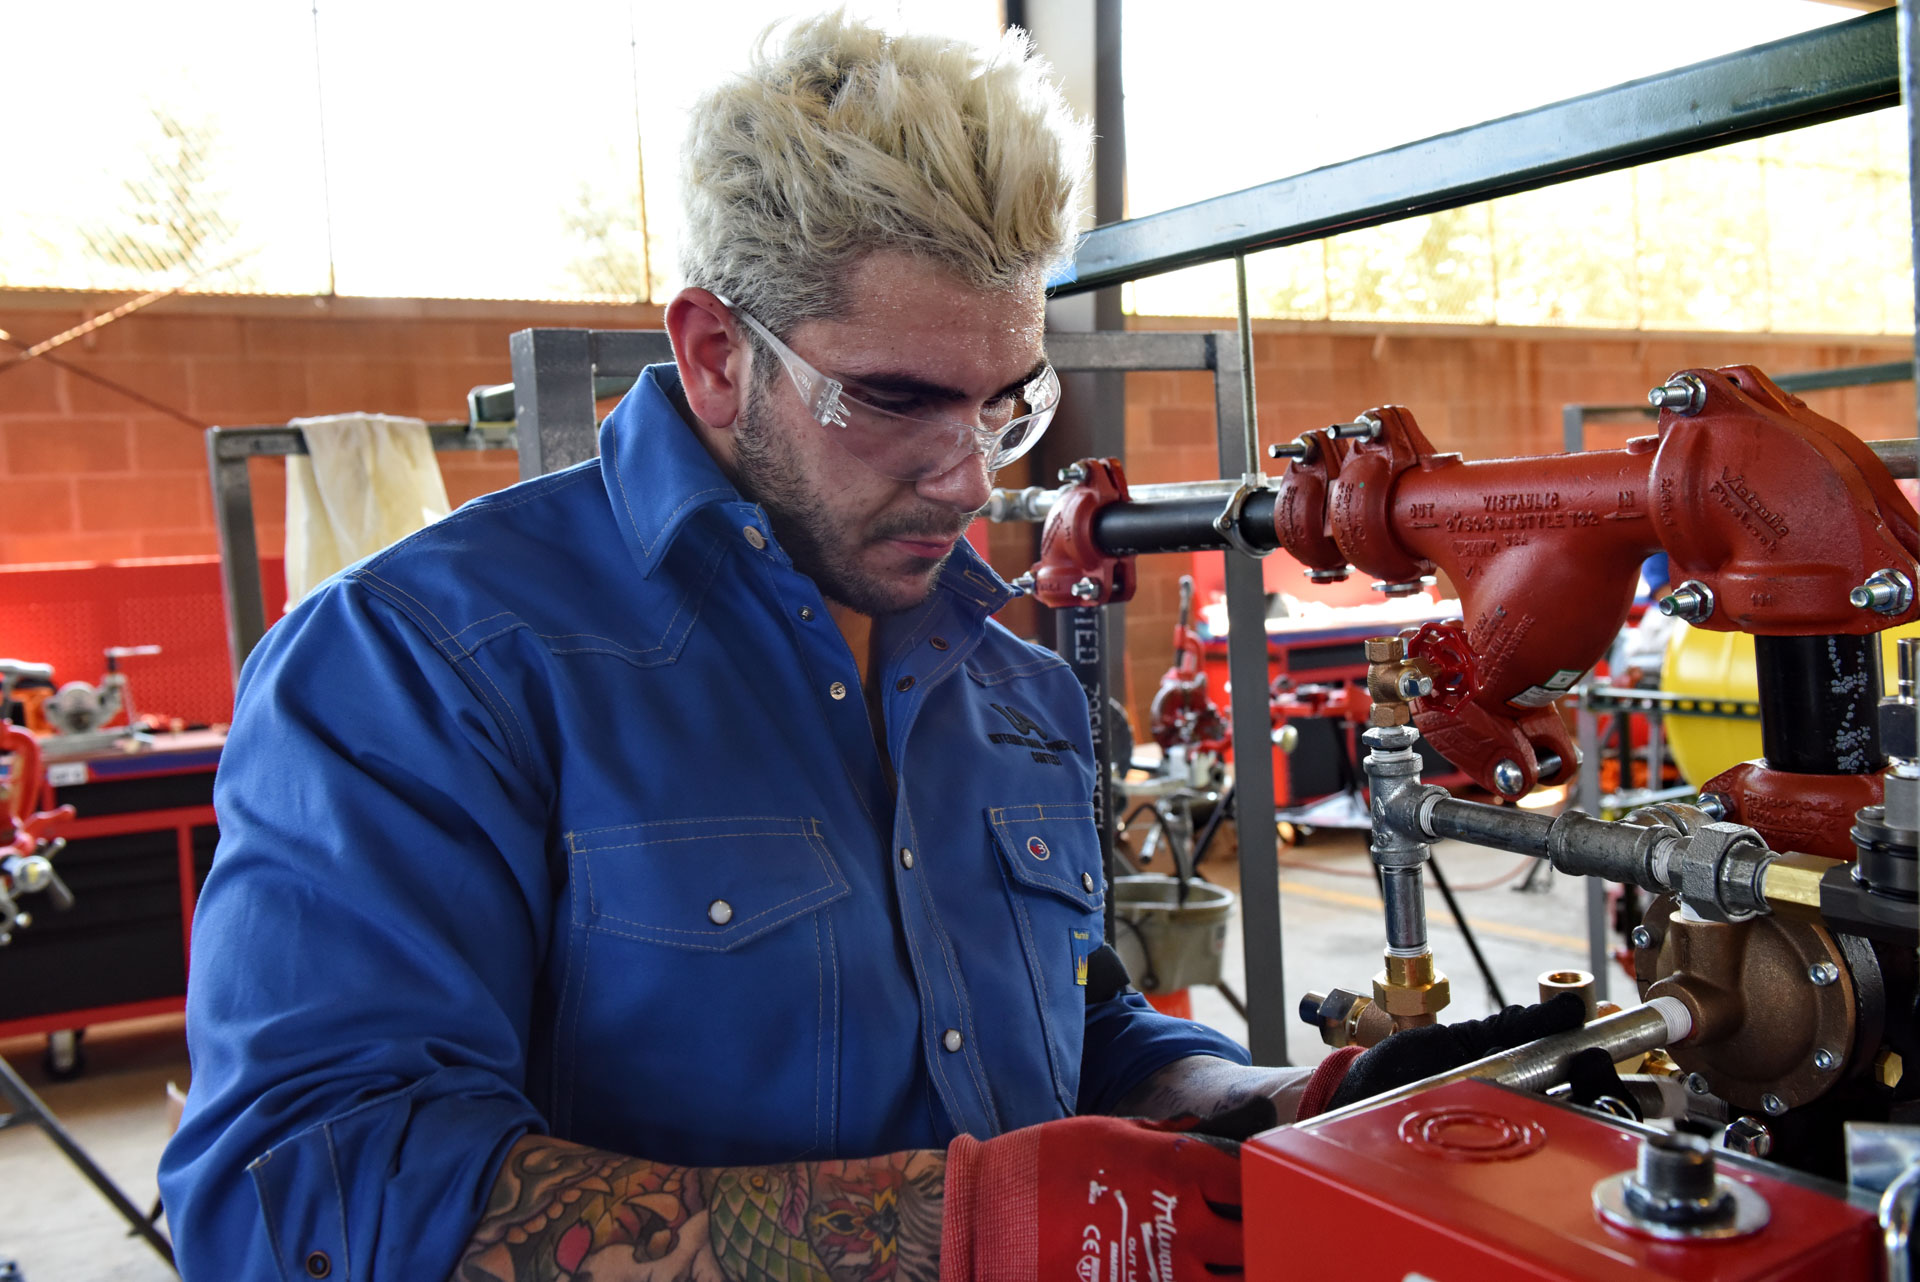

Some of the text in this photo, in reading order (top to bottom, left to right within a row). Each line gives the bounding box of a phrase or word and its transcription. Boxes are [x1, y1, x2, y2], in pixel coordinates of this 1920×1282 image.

[1409, 503, 1435, 518] OUT
[1617, 491, 1635, 508] IN
[1082, 1224, 1101, 1254] CE
[1151, 1189, 1178, 1282] Milwau
